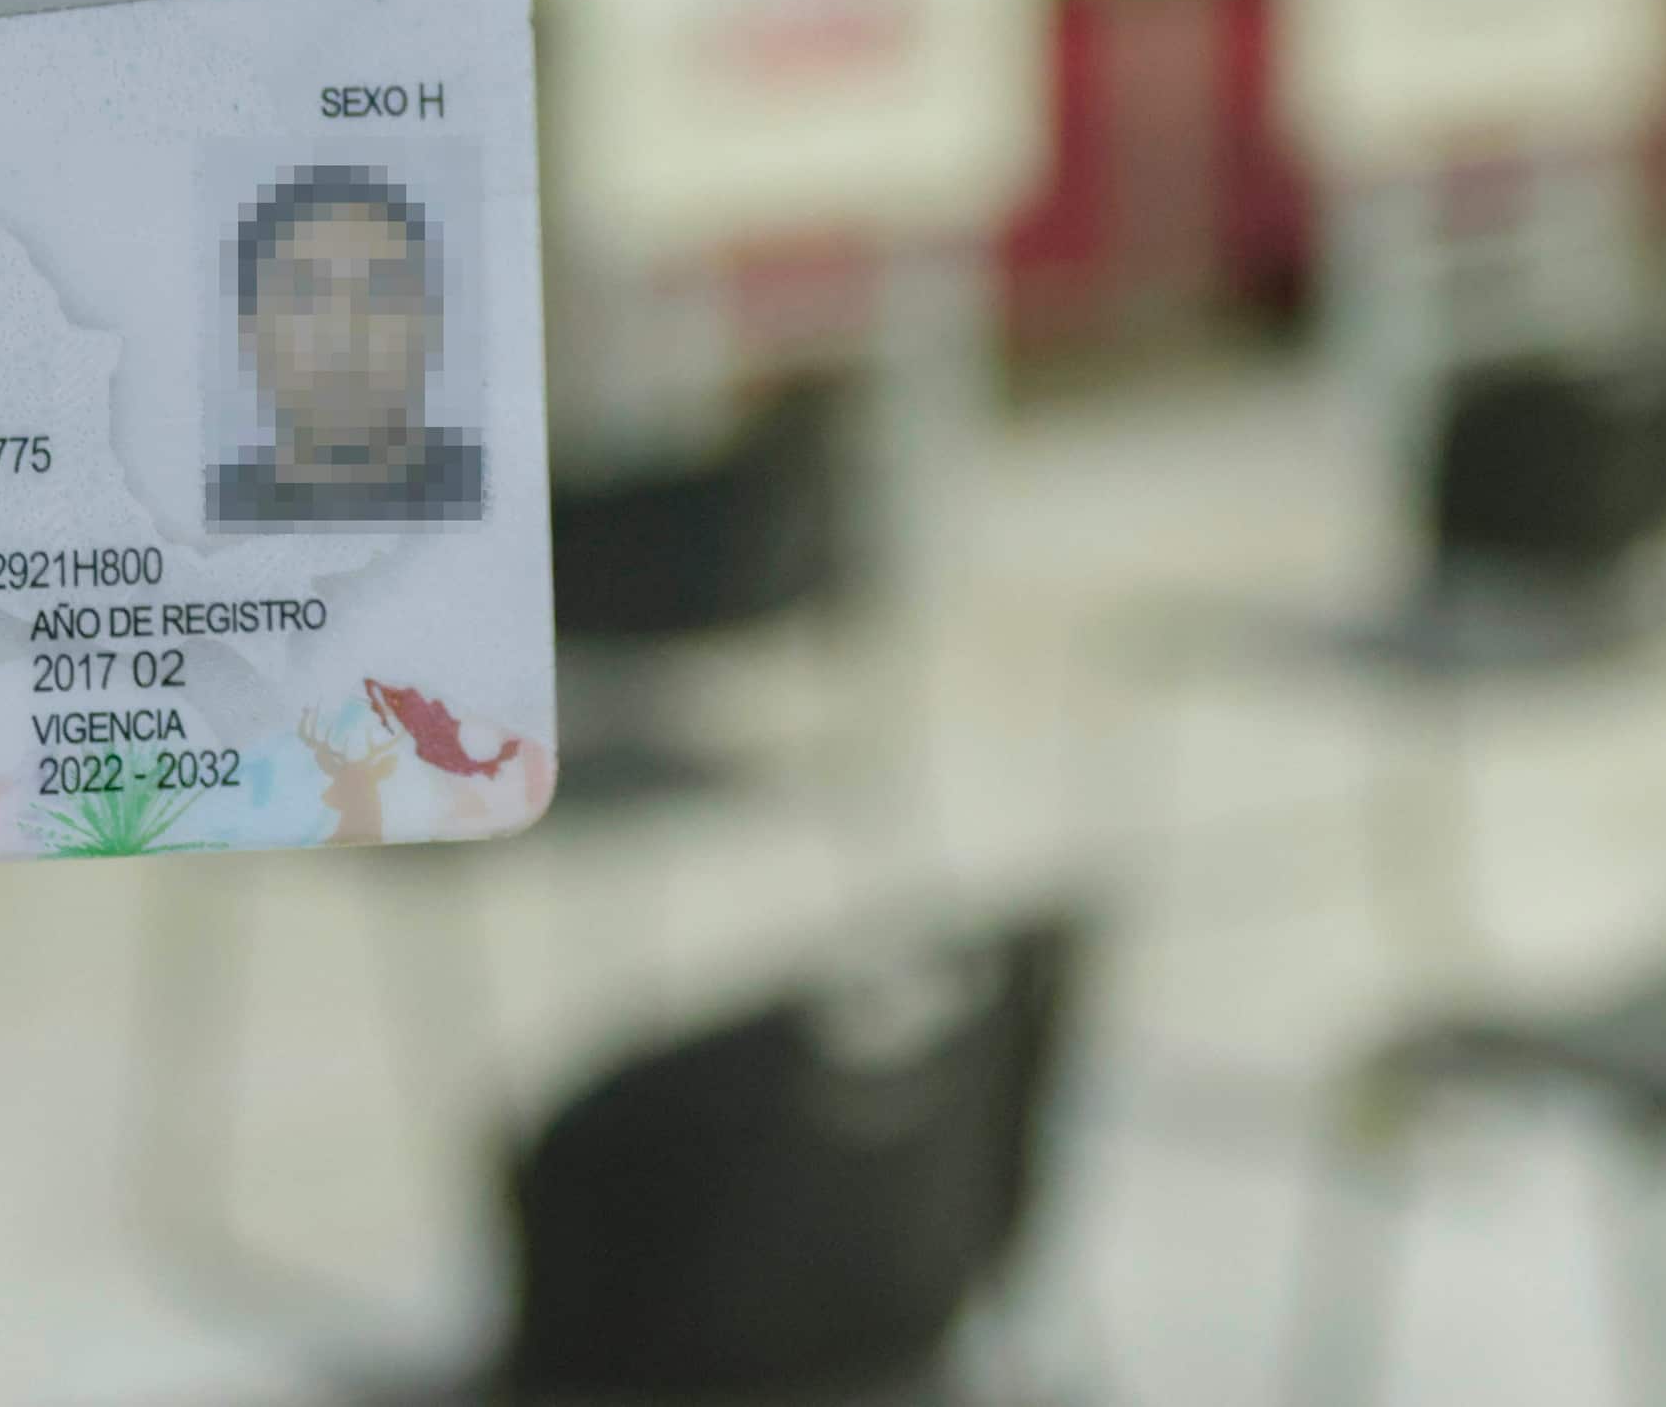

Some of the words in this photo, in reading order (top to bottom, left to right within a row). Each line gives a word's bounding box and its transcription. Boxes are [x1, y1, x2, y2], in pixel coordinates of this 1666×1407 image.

[320, 84, 409, 119] SEXO
[418, 80, 445, 120] H
[30, 602, 102, 641] AÑO
[109, 605, 154, 638] DE
[161, 598, 328, 636] REGISTRO
[33, 652, 117, 693] 2017
[132, 648, 186, 688] 02
[31, 707, 187, 746] VIGENCIA
[38, 754, 124, 796] 2022
[156, 748, 241, 790] 2032
